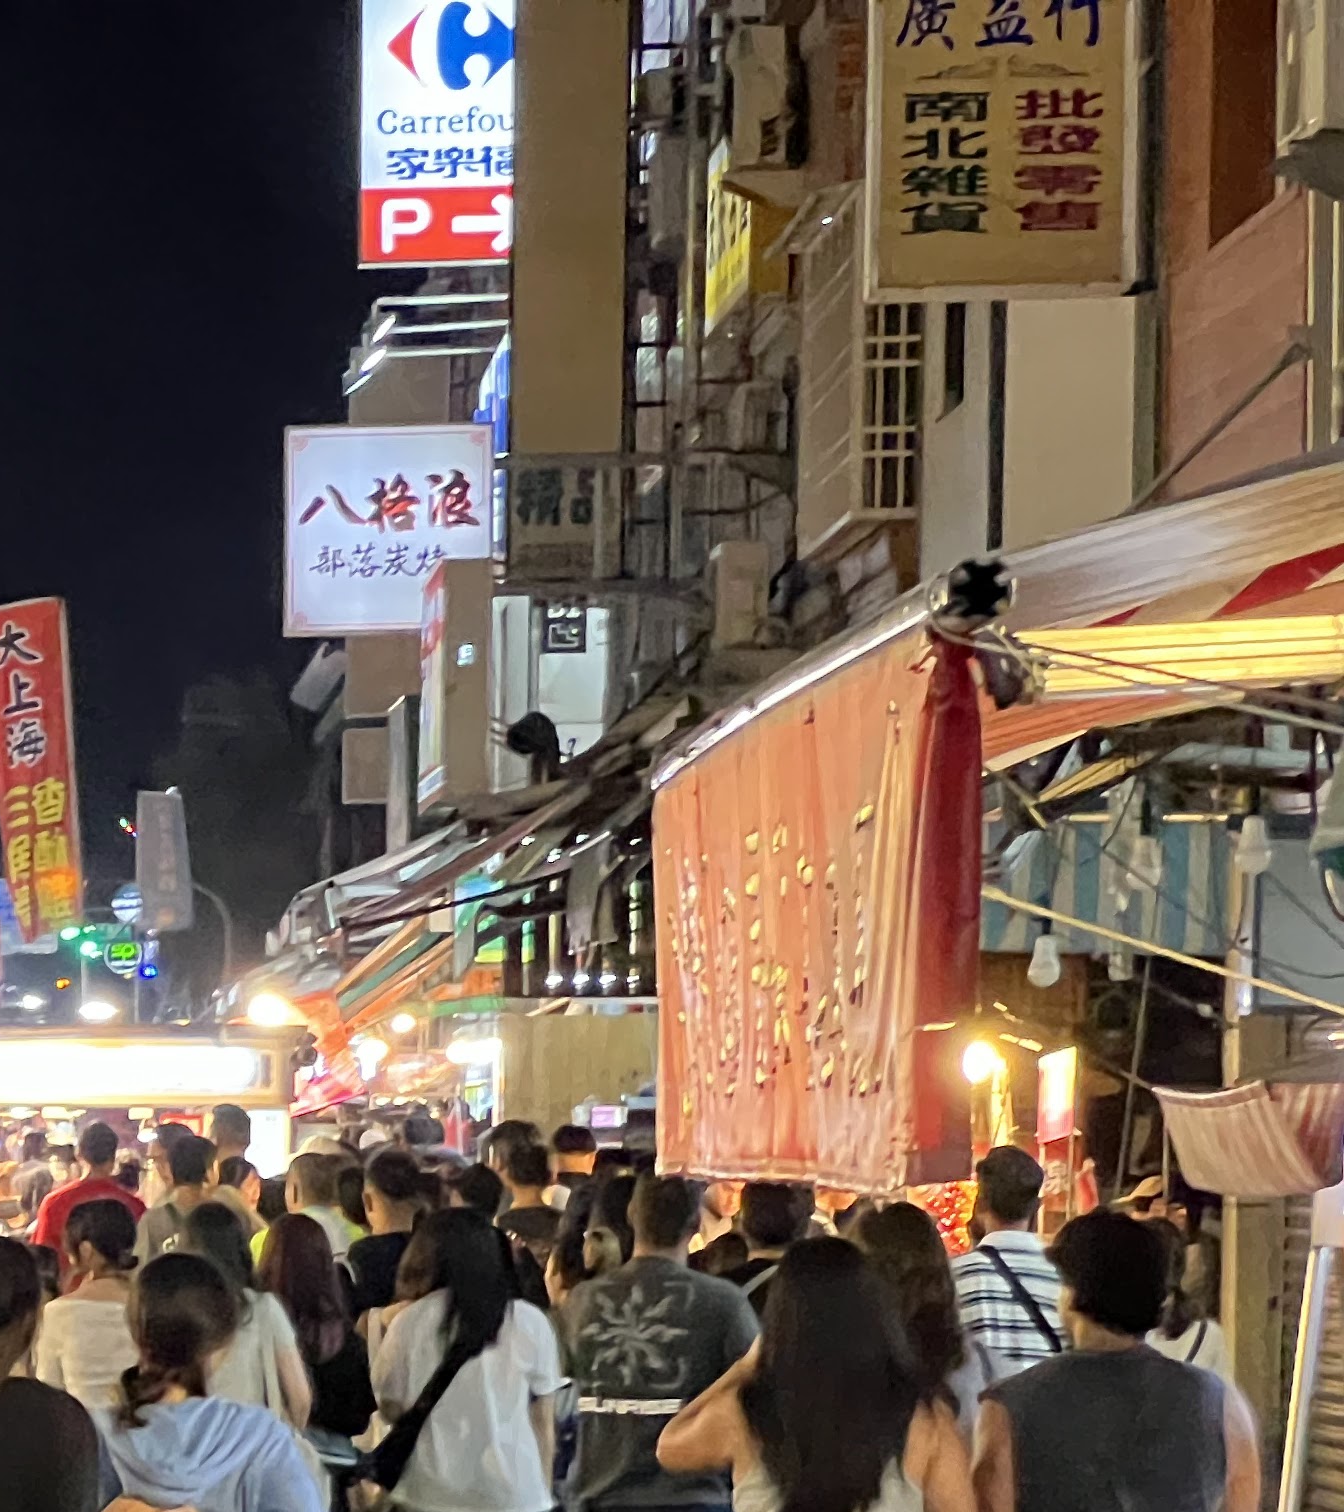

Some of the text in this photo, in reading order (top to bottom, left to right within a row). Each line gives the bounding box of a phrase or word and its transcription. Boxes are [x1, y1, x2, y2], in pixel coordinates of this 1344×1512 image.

[381, 197, 433, 255] P
[298, 468, 480, 534] 八格浪
